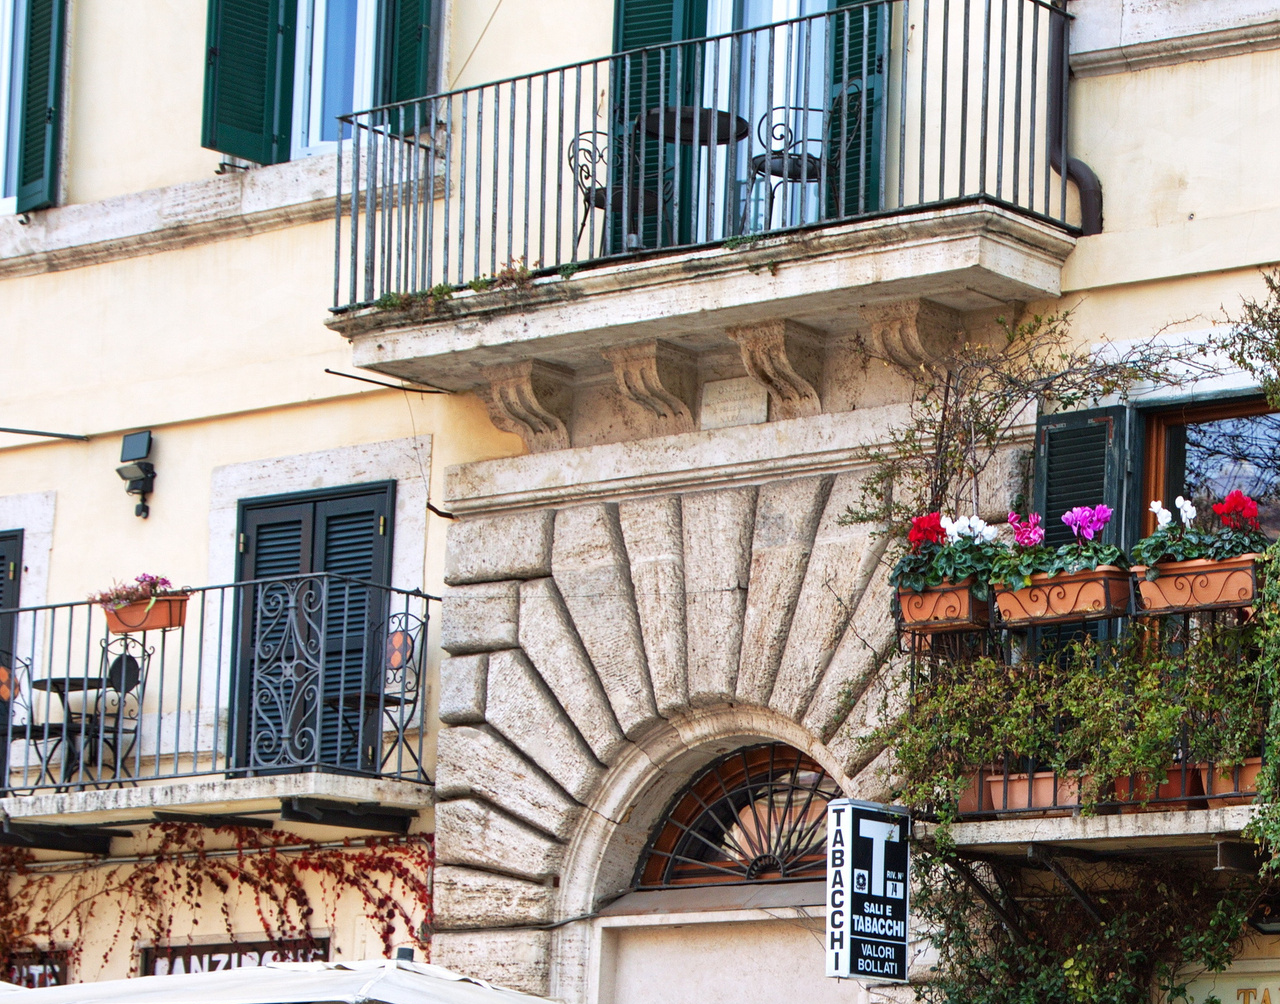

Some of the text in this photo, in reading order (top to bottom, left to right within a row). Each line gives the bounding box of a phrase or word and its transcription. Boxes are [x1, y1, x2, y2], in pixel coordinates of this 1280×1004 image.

[859, 818, 900, 897] T
[830, 808, 846, 971] TABACCHI
[863, 902, 892, 916] SALI E
[852, 914, 905, 938] TABACCHI
[861, 943, 895, 960] VALORI
[858, 958, 898, 975] BOLLATI
